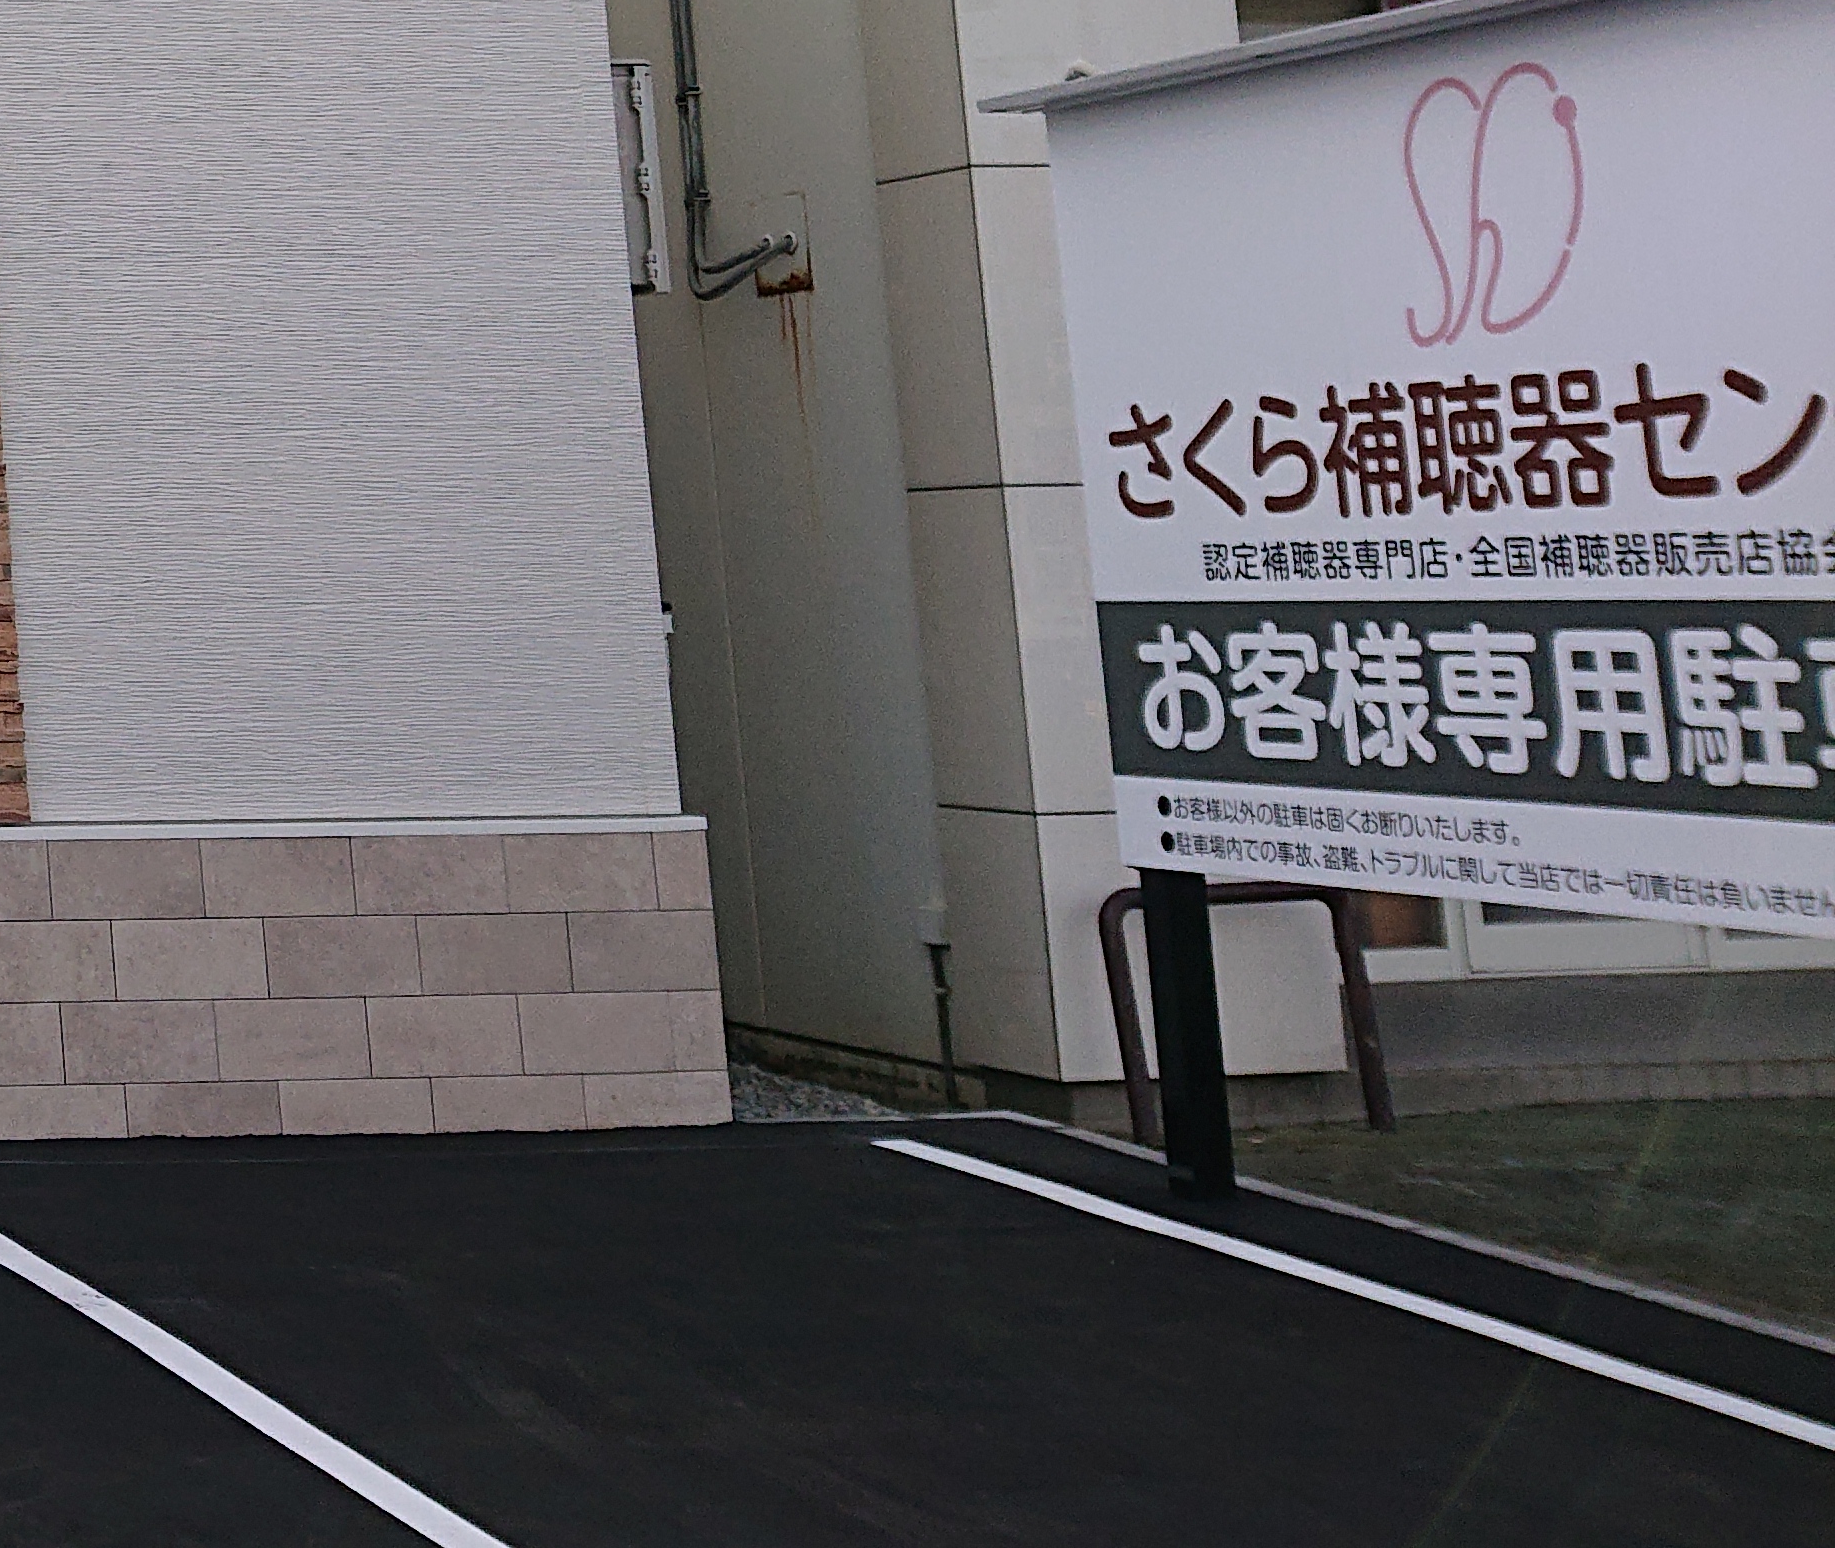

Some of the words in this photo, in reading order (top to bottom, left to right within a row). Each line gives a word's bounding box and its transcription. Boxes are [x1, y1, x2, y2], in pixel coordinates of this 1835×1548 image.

[1108, 361, 1829, 519] さくら補聴器セン
